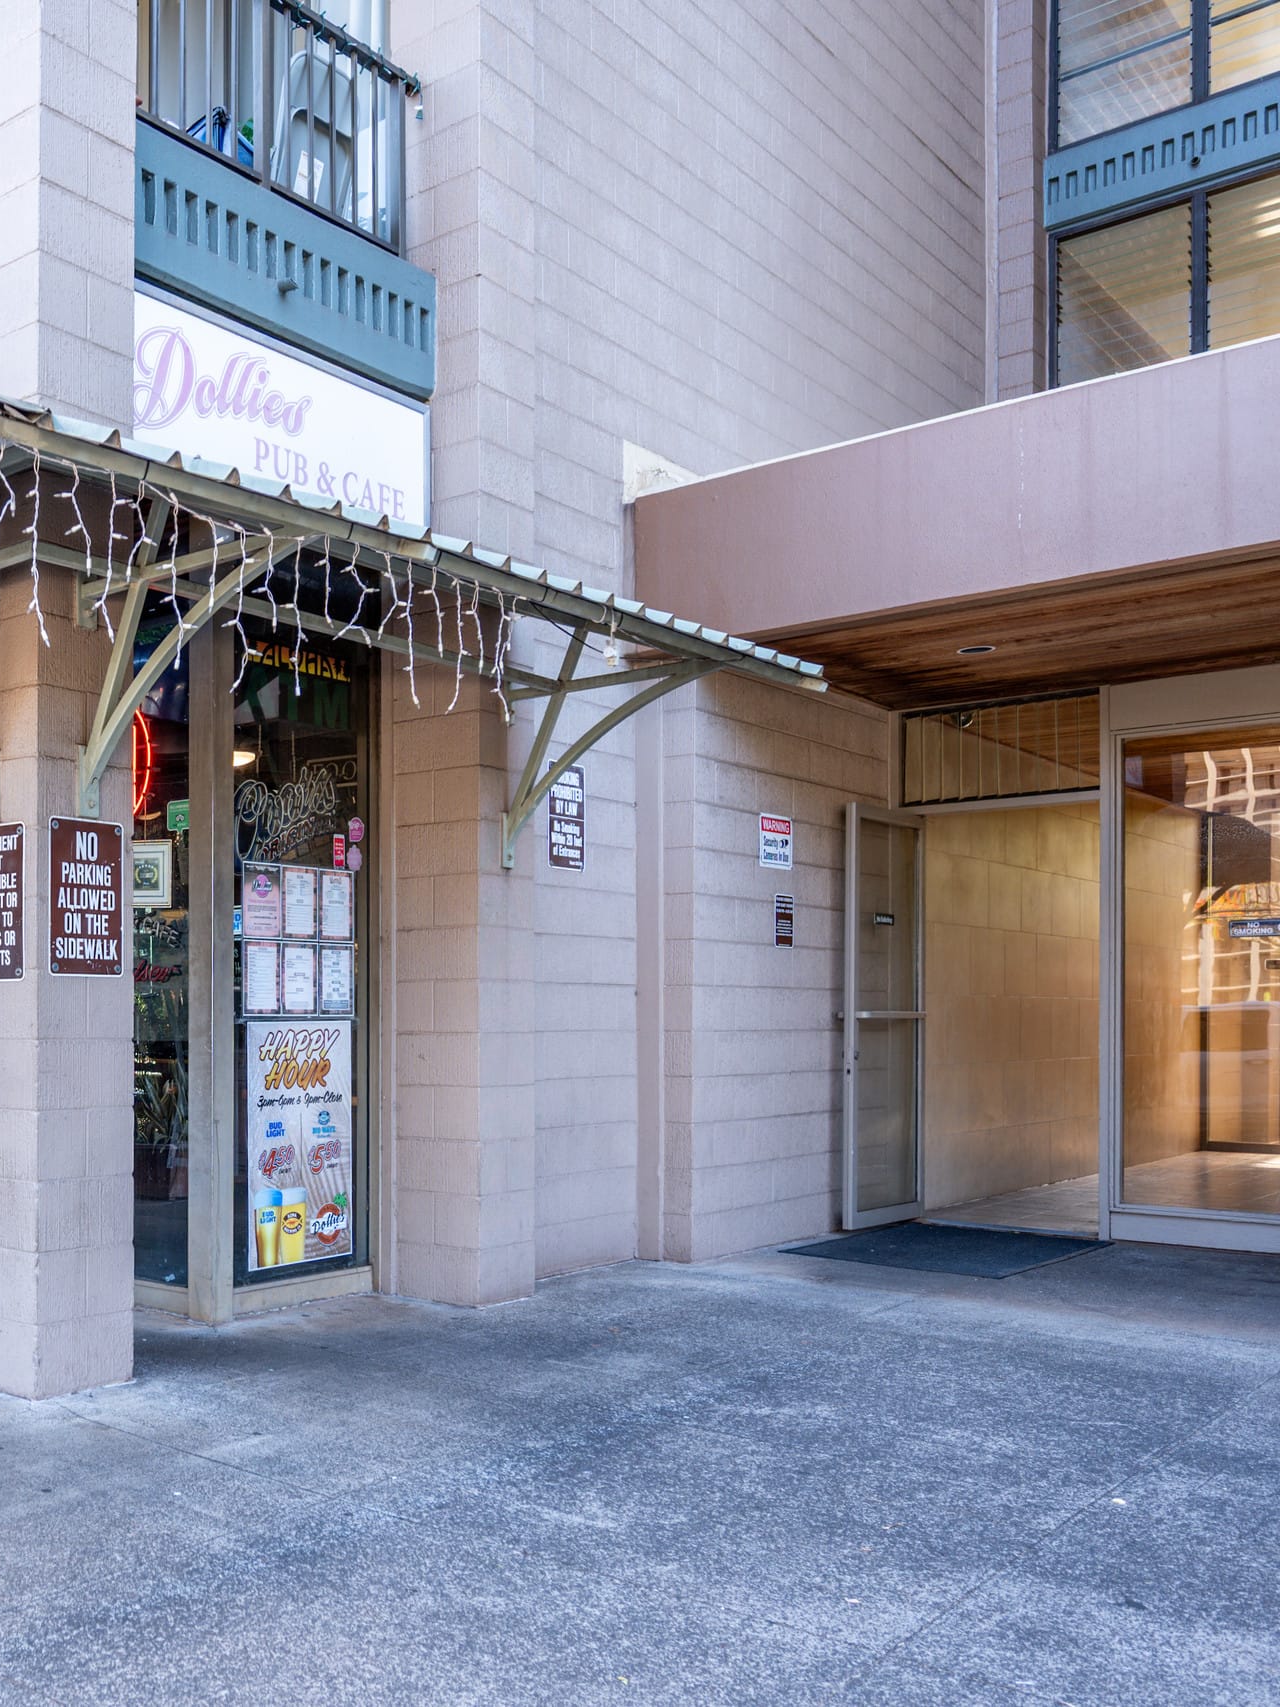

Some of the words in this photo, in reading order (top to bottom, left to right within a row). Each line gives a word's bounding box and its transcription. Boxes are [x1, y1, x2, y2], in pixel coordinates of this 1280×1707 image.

[133, 325, 314, 437] Dollies
[254, 437, 308, 487] PUB
[317, 461, 335, 498] &
[343, 471, 406, 521] CAFE
[551, 783, 583, 802] PROHIBITED
[555, 799, 564, 815] BY
[565, 801, 578, 816] LAW
[762, 818, 790, 834] WARNING
[75, 831, 98, 861] NO
[763, 835, 779, 849] Security
[62, 862, 111, 887] PARKING
[7, 892, 17, 907] OR
[58, 887, 115, 911] ALLOWED
[2, 911, 13, 927] TO
[64, 912, 81, 935] ON
[85, 914, 109, 935] THE
[4, 931, 16, 947] OR
[1233, 928, 1273, 937] SMOKING
[55, 937, 118, 960] SIDEWALK
[259, 1029, 340, 1061] HAPPY
[264, 1058, 331, 1091] HOUR
[266, 1129, 285, 1137] LIGHT
